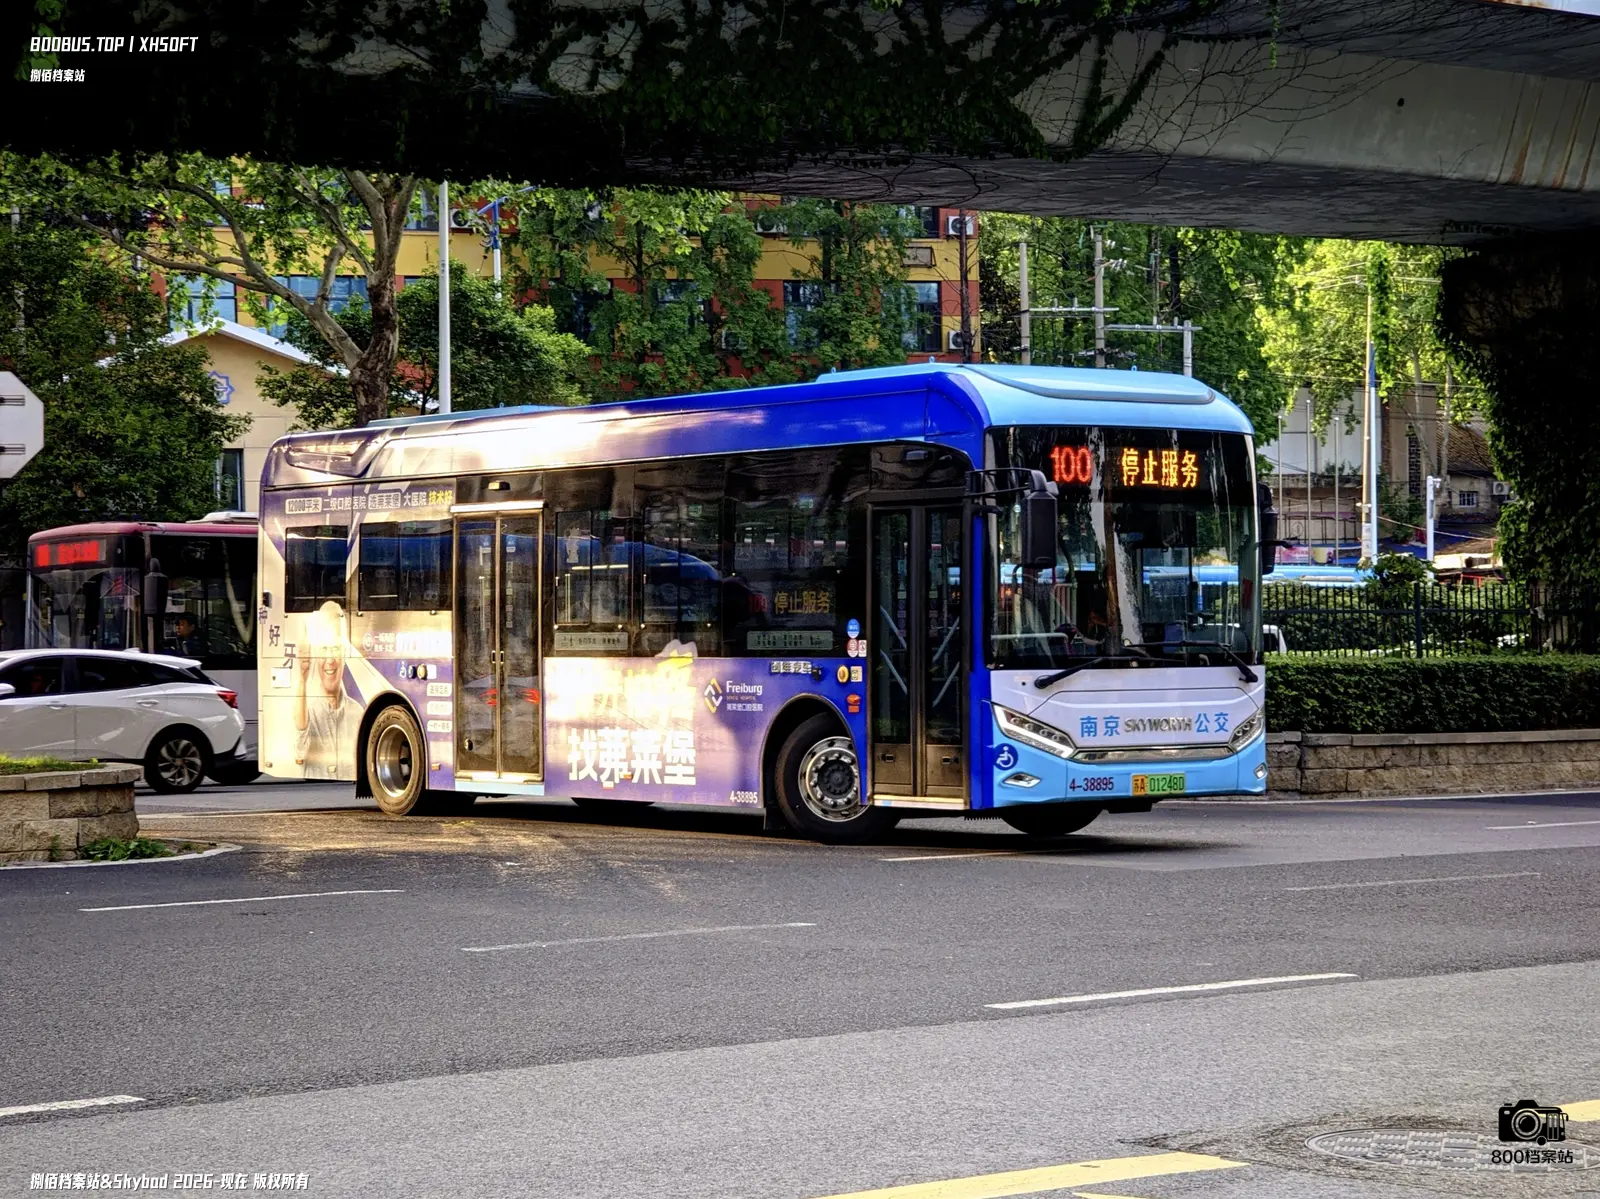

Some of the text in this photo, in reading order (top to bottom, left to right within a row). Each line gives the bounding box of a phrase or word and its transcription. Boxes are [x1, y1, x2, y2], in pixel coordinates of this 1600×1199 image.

[1050, 446, 1092, 483] 100
[1121, 447, 1199, 488] 停止服务
[403, 491, 428, 507] 大医院
[774, 590, 831, 614] 停止服务
[725, 680, 763, 695] Freiburg
[1079, 712, 1230, 738] 南京 SKYWORTH 公交
[1068, 777, 1115, 792] 4-38895
[729, 790, 759, 804] 4-38895
